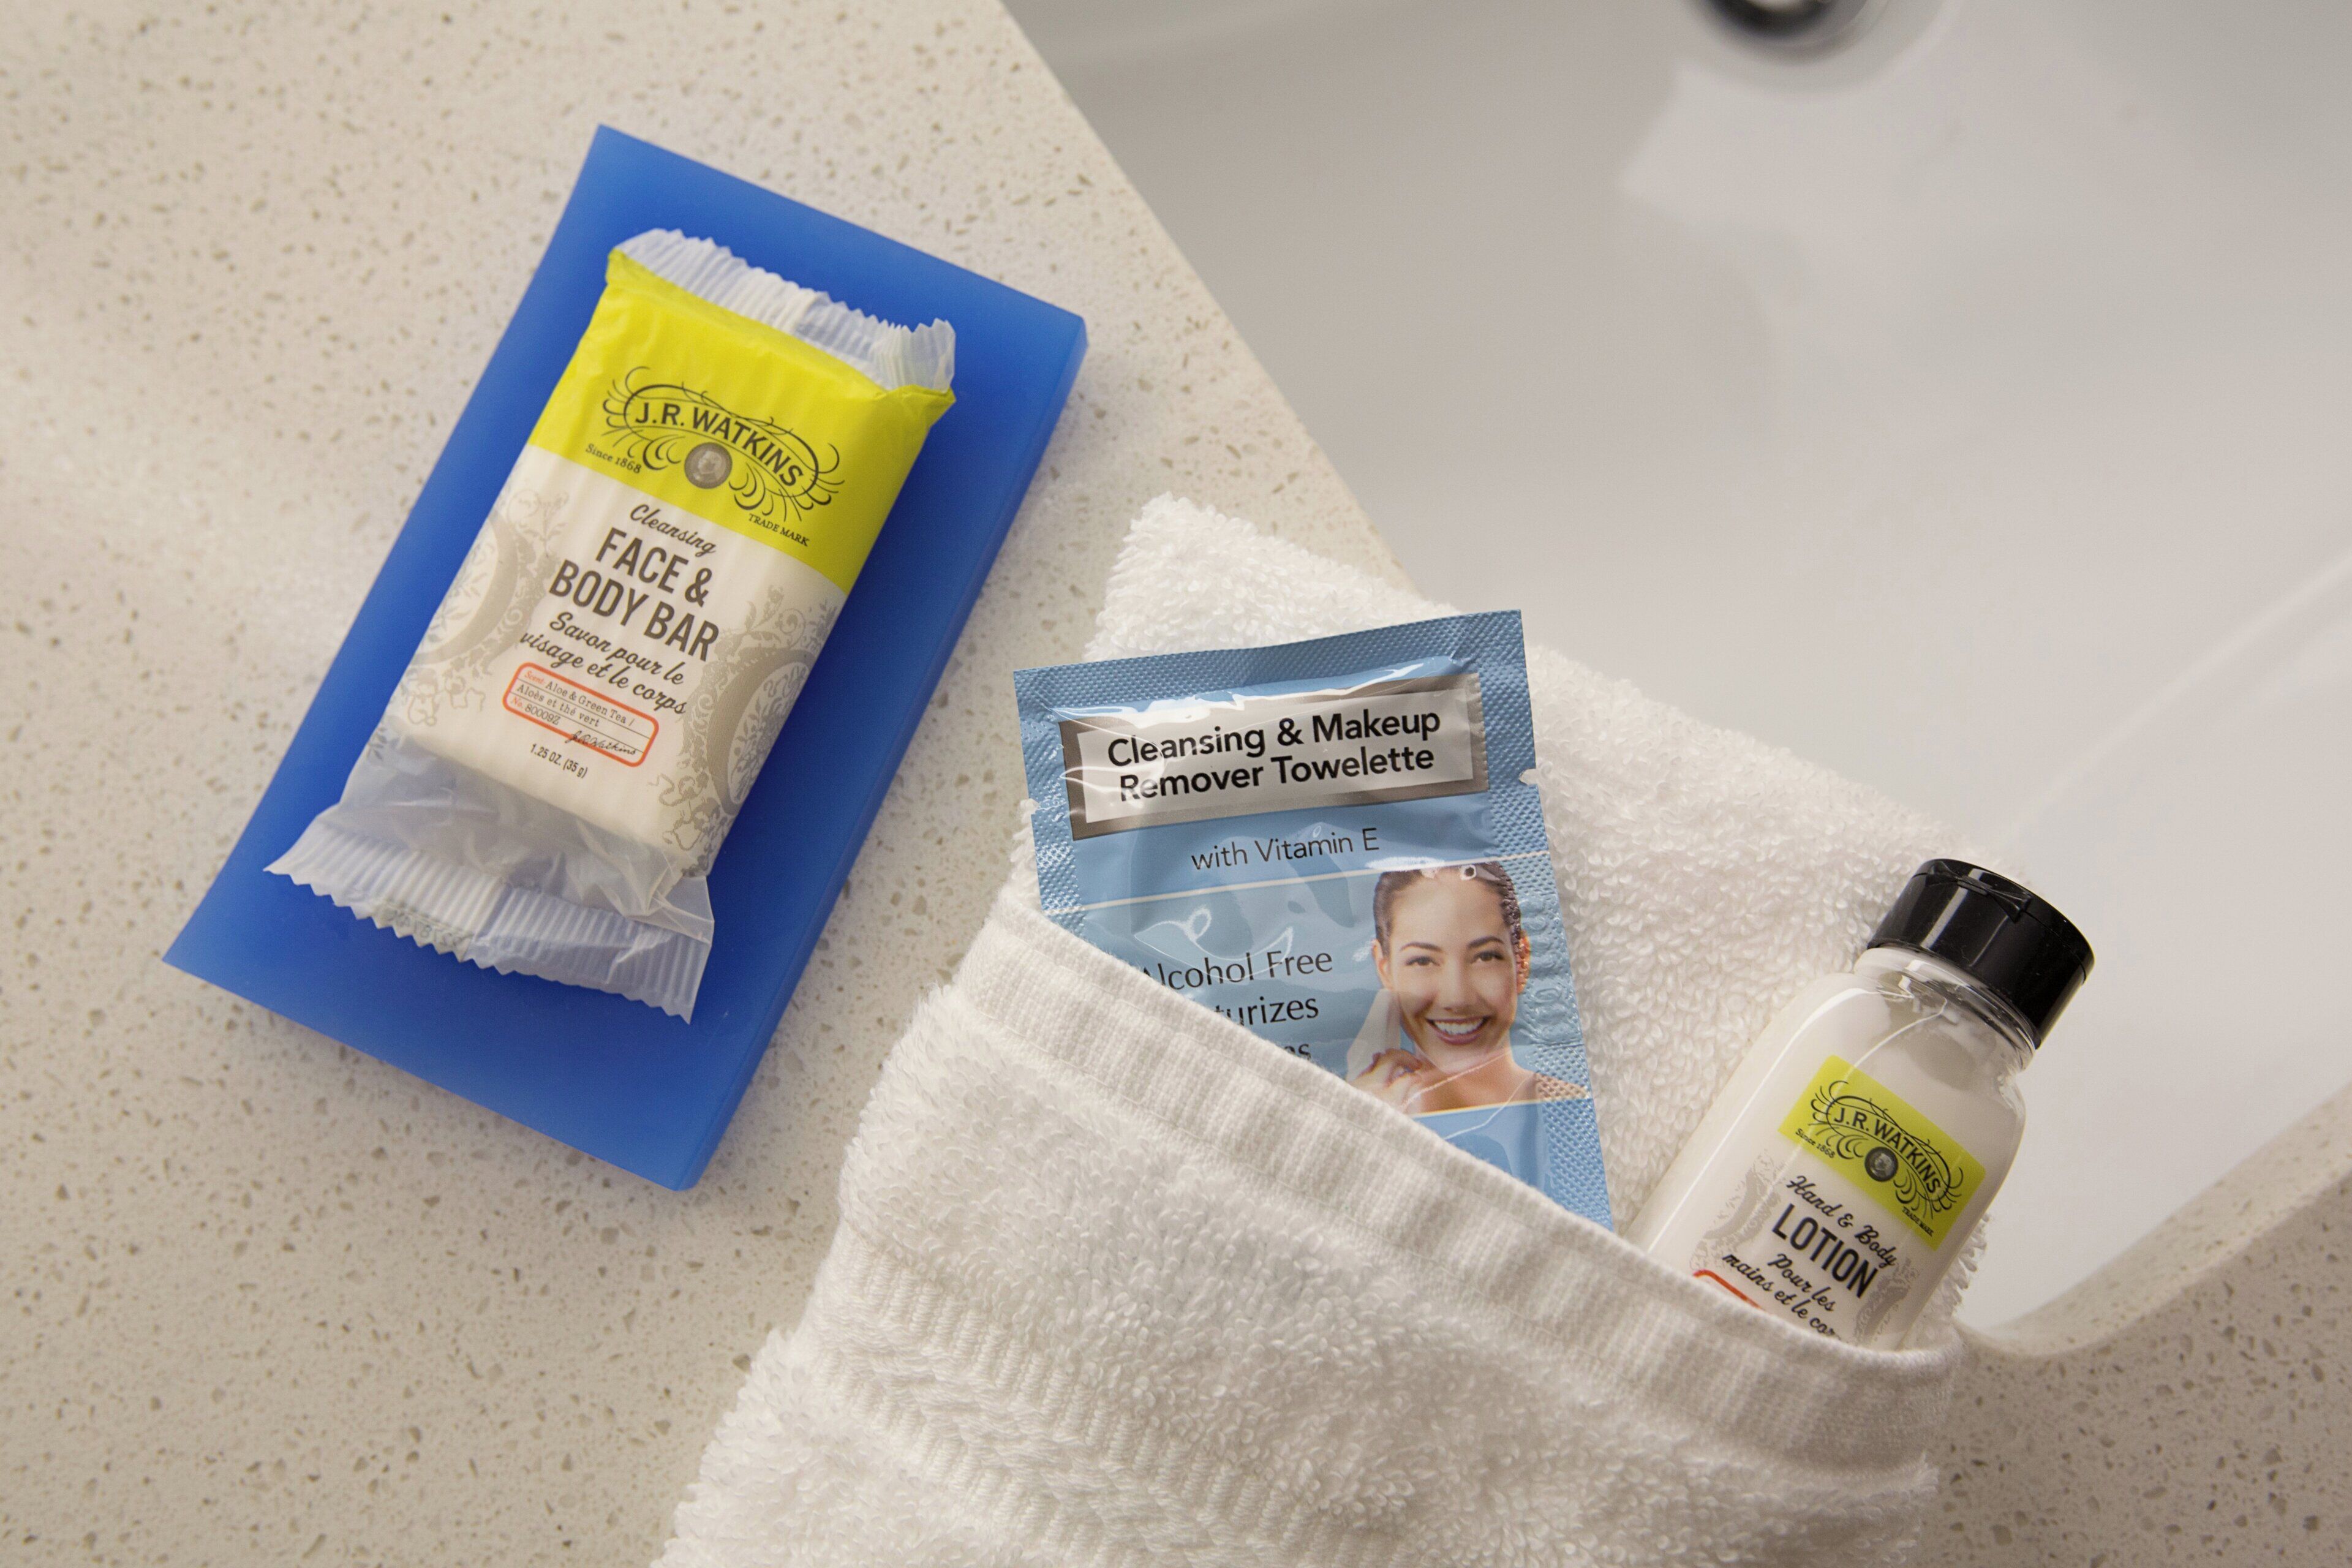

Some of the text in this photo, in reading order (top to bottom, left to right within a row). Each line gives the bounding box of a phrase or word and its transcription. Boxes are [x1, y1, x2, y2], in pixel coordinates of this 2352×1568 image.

[586, 443, 643, 475] Since 1868
[635, 402, 805, 488] J.R. WATKINS
[630, 503, 717, 557] Cleansing
[748, 513, 810, 547] TRADE MARK
[595, 527, 713, 608] FACE &
[549, 559, 720, 662] BODY BAR
[520, 632, 688, 715] visage et le corps
[550, 611, 685, 685] Savon pour le
[516, 684, 600, 728] Aloès et thé vert
[545, 680, 568, 700] Aloe
[568, 691, 578, 701] &
[578, 695, 608, 716] Green
[611, 709, 627, 725] Tea
[530, 743, 549, 760] 1.25
[563, 758, 578, 773] (35
[578, 766, 589, 779] g)
[1107, 709, 1442, 767] Cleansing & Makeup
[1120, 745, 1435, 802] Remover Towelette
[1191, 827, 1380, 870] with Vitamin E
[1143, 950, 1333, 990] lcohol Free
[1795, 1128, 1836, 1159] Since 1868
[1833, 1107, 1941, 1194] J.R. WATKINS
[1771, 1202, 1879, 1299] LOTION
[1786, 1175, 1898, 1269] Hand & Body
[1721, 1254, 1774, 1292] mains
[1774, 1289, 1797, 1306] et
[1790, 1298, 1812, 1318] le
[1766, 1253, 1836, 1312] Pour les
